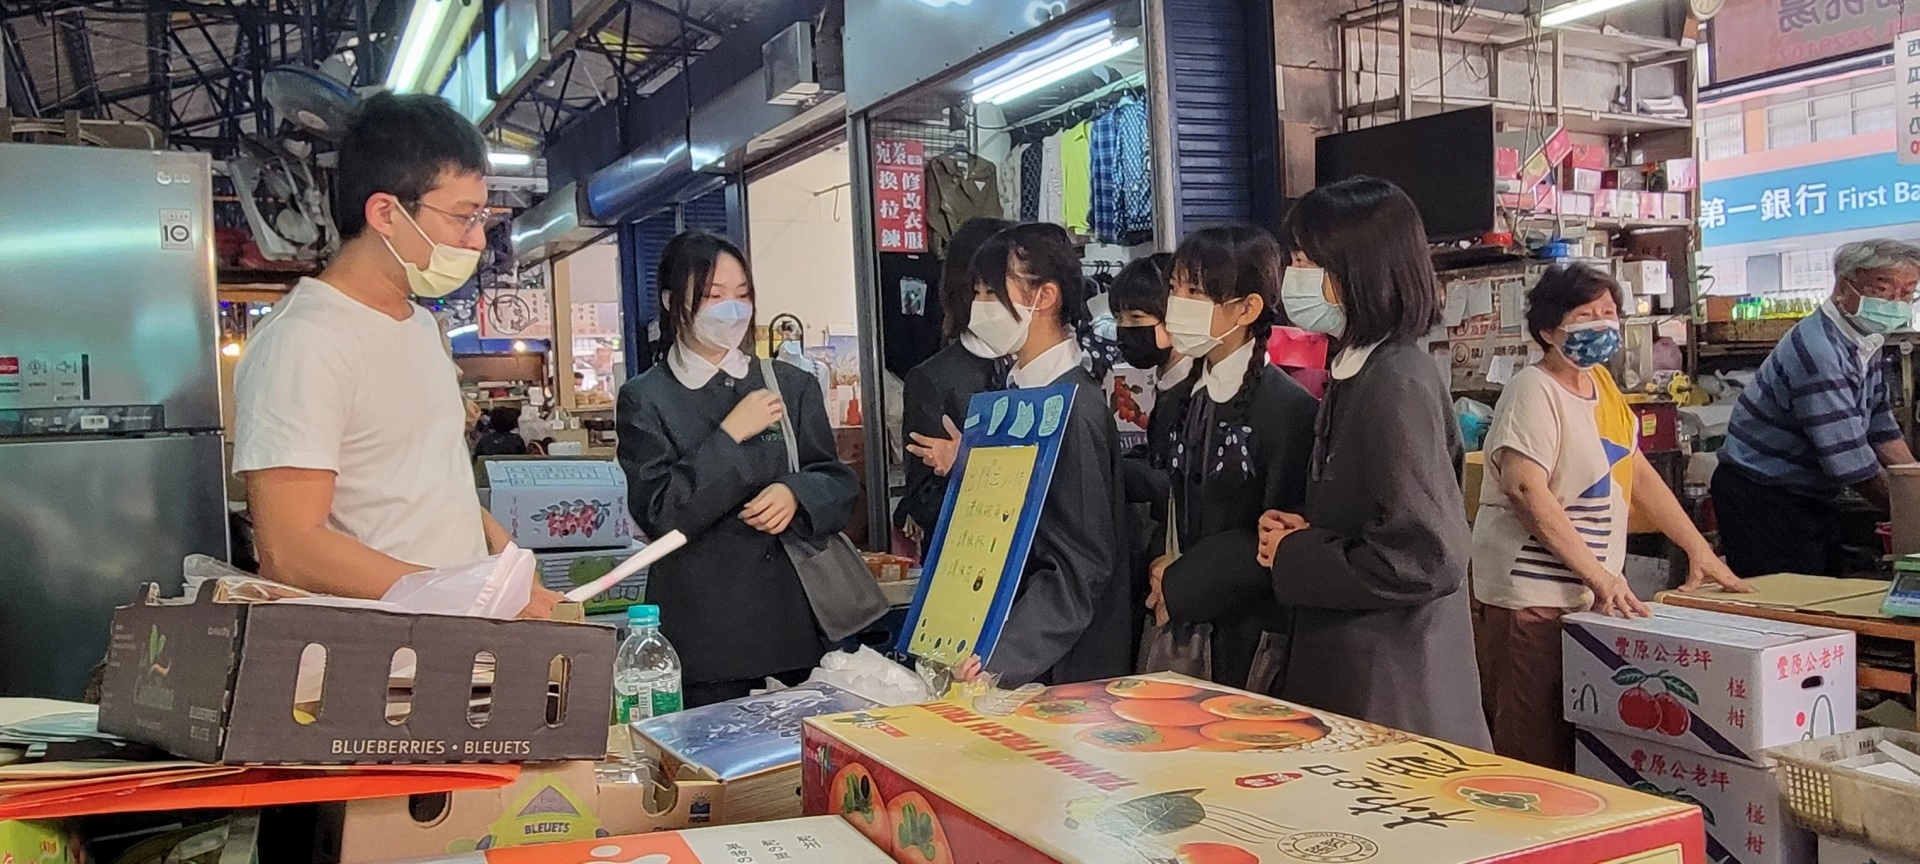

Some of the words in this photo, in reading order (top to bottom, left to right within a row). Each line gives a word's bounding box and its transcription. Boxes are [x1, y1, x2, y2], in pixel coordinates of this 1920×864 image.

[174, 173, 191, 184] LG
[902, 172, 923, 249] 修改衣服
[1698, 183, 1828, 229] 第一銀行
[1838, 186, 1888, 212] First
[163, 224, 190, 243] 10
[1615, 636, 1713, 671] 豐原公老坪
[1777, 645, 1845, 680] 豐原公老坪
[915, 701, 984, 723] FRUIT
[1726, 676, 1747, 729] 椪柑
[331, 739, 446, 755] BLUEBERRIES
[463, 740, 531, 755] BLEUETS
[964, 722, 1048, 752] FRESH
[1028, 750, 1139, 791] TAIWAN
[1630, 749, 1731, 793] 豐原公老坪
[524, 821, 571, 836] BLEUETS
